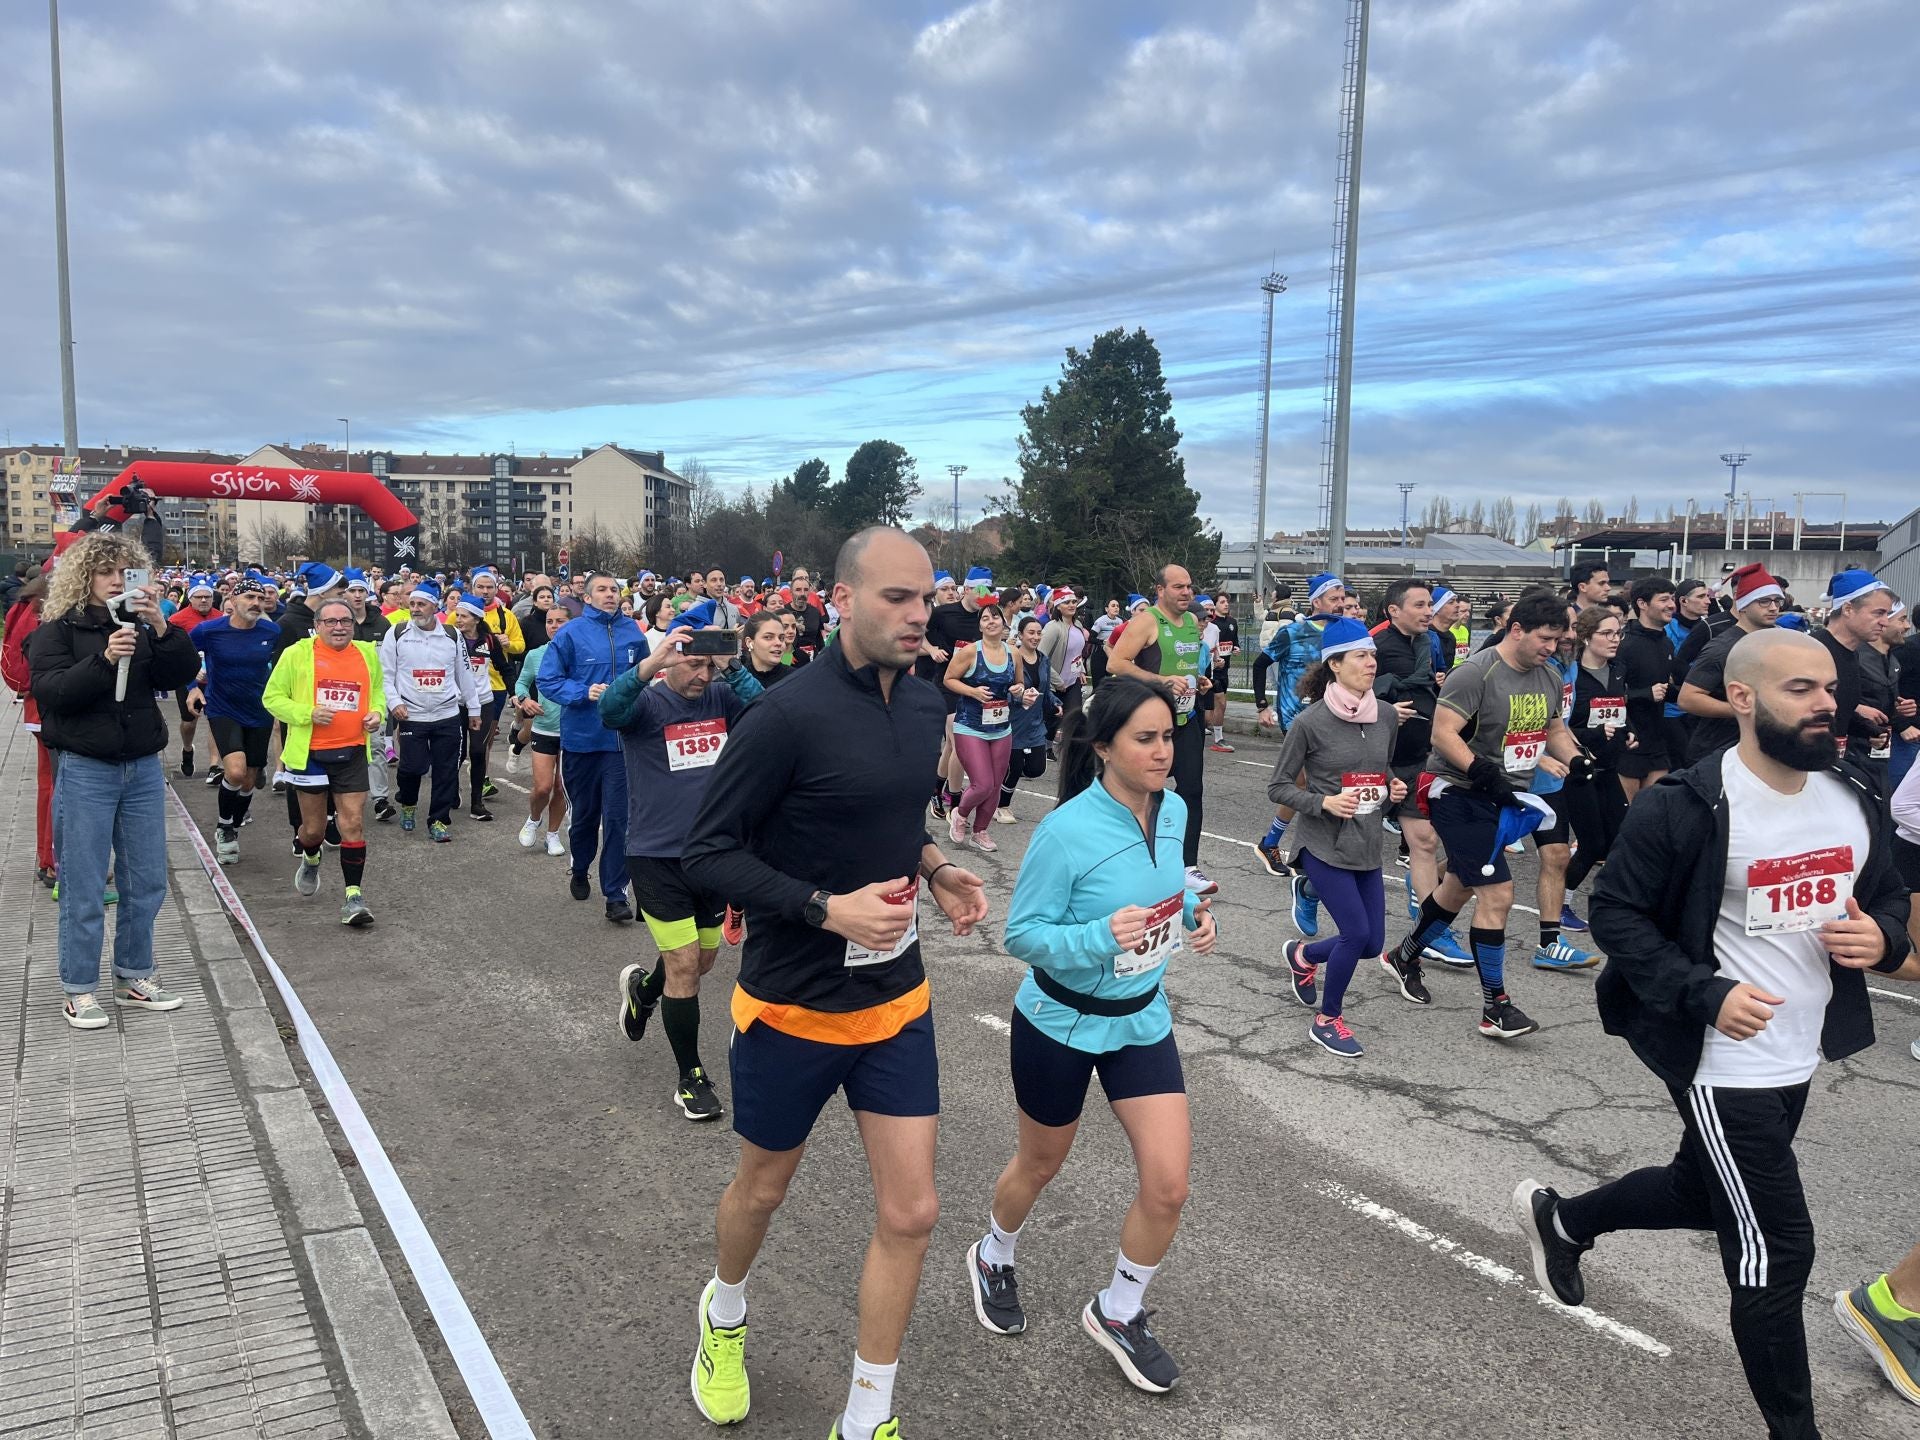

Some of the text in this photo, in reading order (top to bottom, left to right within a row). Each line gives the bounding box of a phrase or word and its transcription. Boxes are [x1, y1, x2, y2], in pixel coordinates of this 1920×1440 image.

[53, 474, 79, 483] CIRCO DE
[49, 482, 75, 492] NAVIDAD
[417, 677, 442, 687] 1489
[323, 690, 355, 702] 1876
[1597, 708, 1620, 720] 384
[675, 735, 721, 756] 1389
[1766, 878, 1837, 913] 1188
[1134, 921, 1171, 956] 672
